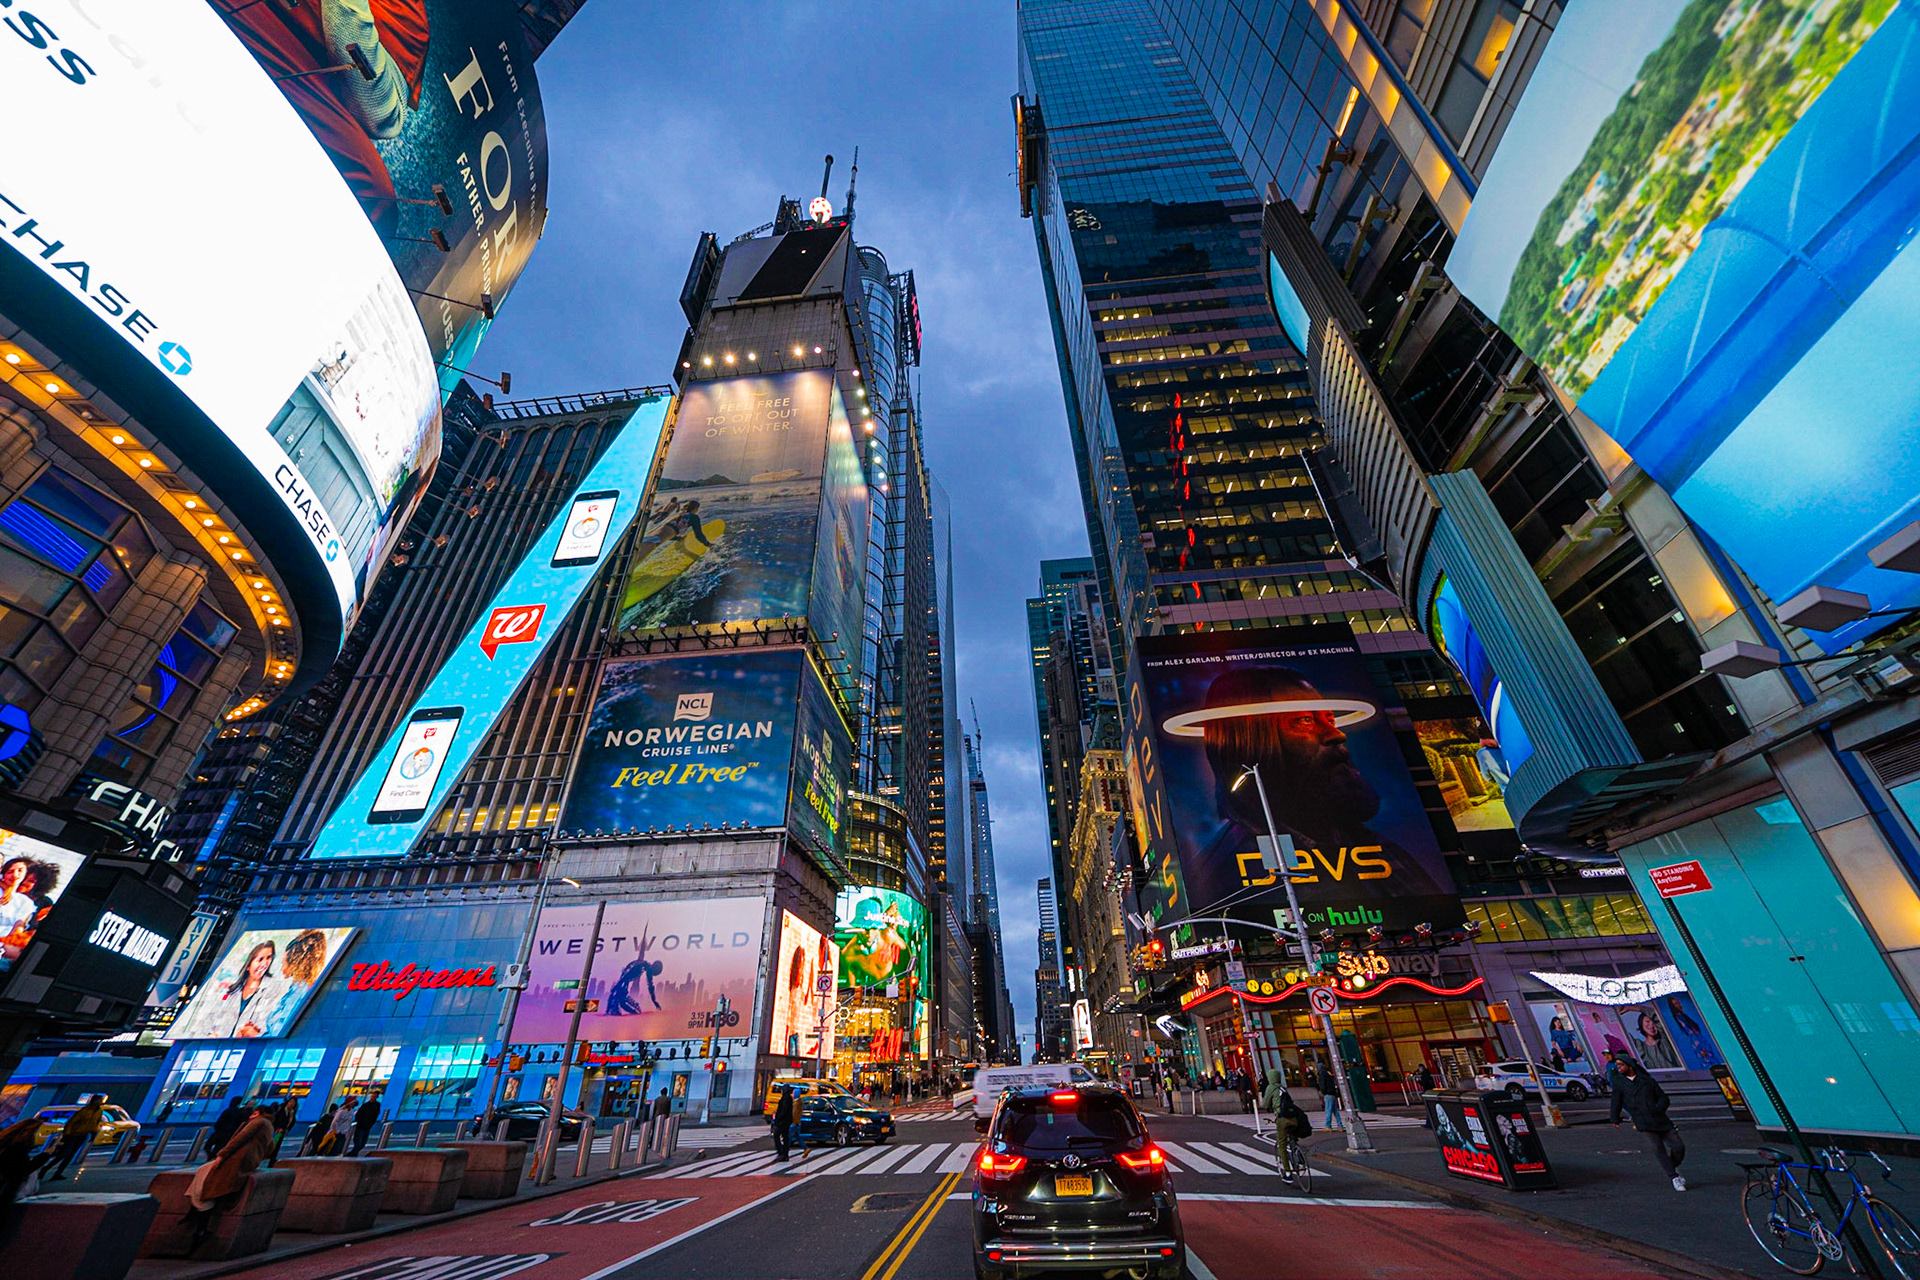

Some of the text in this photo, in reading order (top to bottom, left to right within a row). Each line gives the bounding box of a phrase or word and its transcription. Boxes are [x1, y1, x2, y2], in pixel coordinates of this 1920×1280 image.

[0, 0, 97, 85] SS
[498, 40, 518, 93] From
[516, 96, 538, 181] Executive
[456, 152, 484, 235] FATHER.
[757, 397, 791, 409] FREE
[705, 408, 800, 426] TO OPT OUT
[705, 421, 794, 438] OF WINTER.
[274, 463, 330, 545] CHASE
[1186, 655, 1225, 665] GARLAND,
[1225, 650, 1297, 661] WRITER/DIRECTOR
[1319, 646, 1355, 655] MACHINA
[678, 698, 709, 710] NCL
[604, 721, 773, 748] NORWEGIAN
[641, 746, 692, 758] CRUISE
[611, 763, 679, 788] Feel
[802, 734, 844, 805] NORWEGIAN
[90, 781, 169, 843] CHA
[804, 780, 840, 834] Feel Free
[1582, 867, 1626, 878] OUTFRONT
[1652, 865, 1694, 878] NO STANDING
[1657, 875, 1683, 885] Anytime
[1308, 912, 1325, 923] ON
[1326, 905, 1384, 926] hulu
[89, 911, 171, 968] STEVE MADDEN
[166, 915, 207, 985] NYPD
[539, 931, 750, 956] WESTWORLD
[1174, 946, 1208, 959] OUTFRONT
[1336, 950, 1440, 978] Subway
[347, 959, 498, 1001] Walgreens
[1310, 977, 1327, 985] NEW
[1586, 979, 1657, 998] LOFT
[687, 1020, 704, 1029] 9PM
[690, 1010, 740, 1028] 3.15 HBO
[1443, 1145, 1499, 1174] CHICAGO
[529, 1197, 699, 1227] BUS
